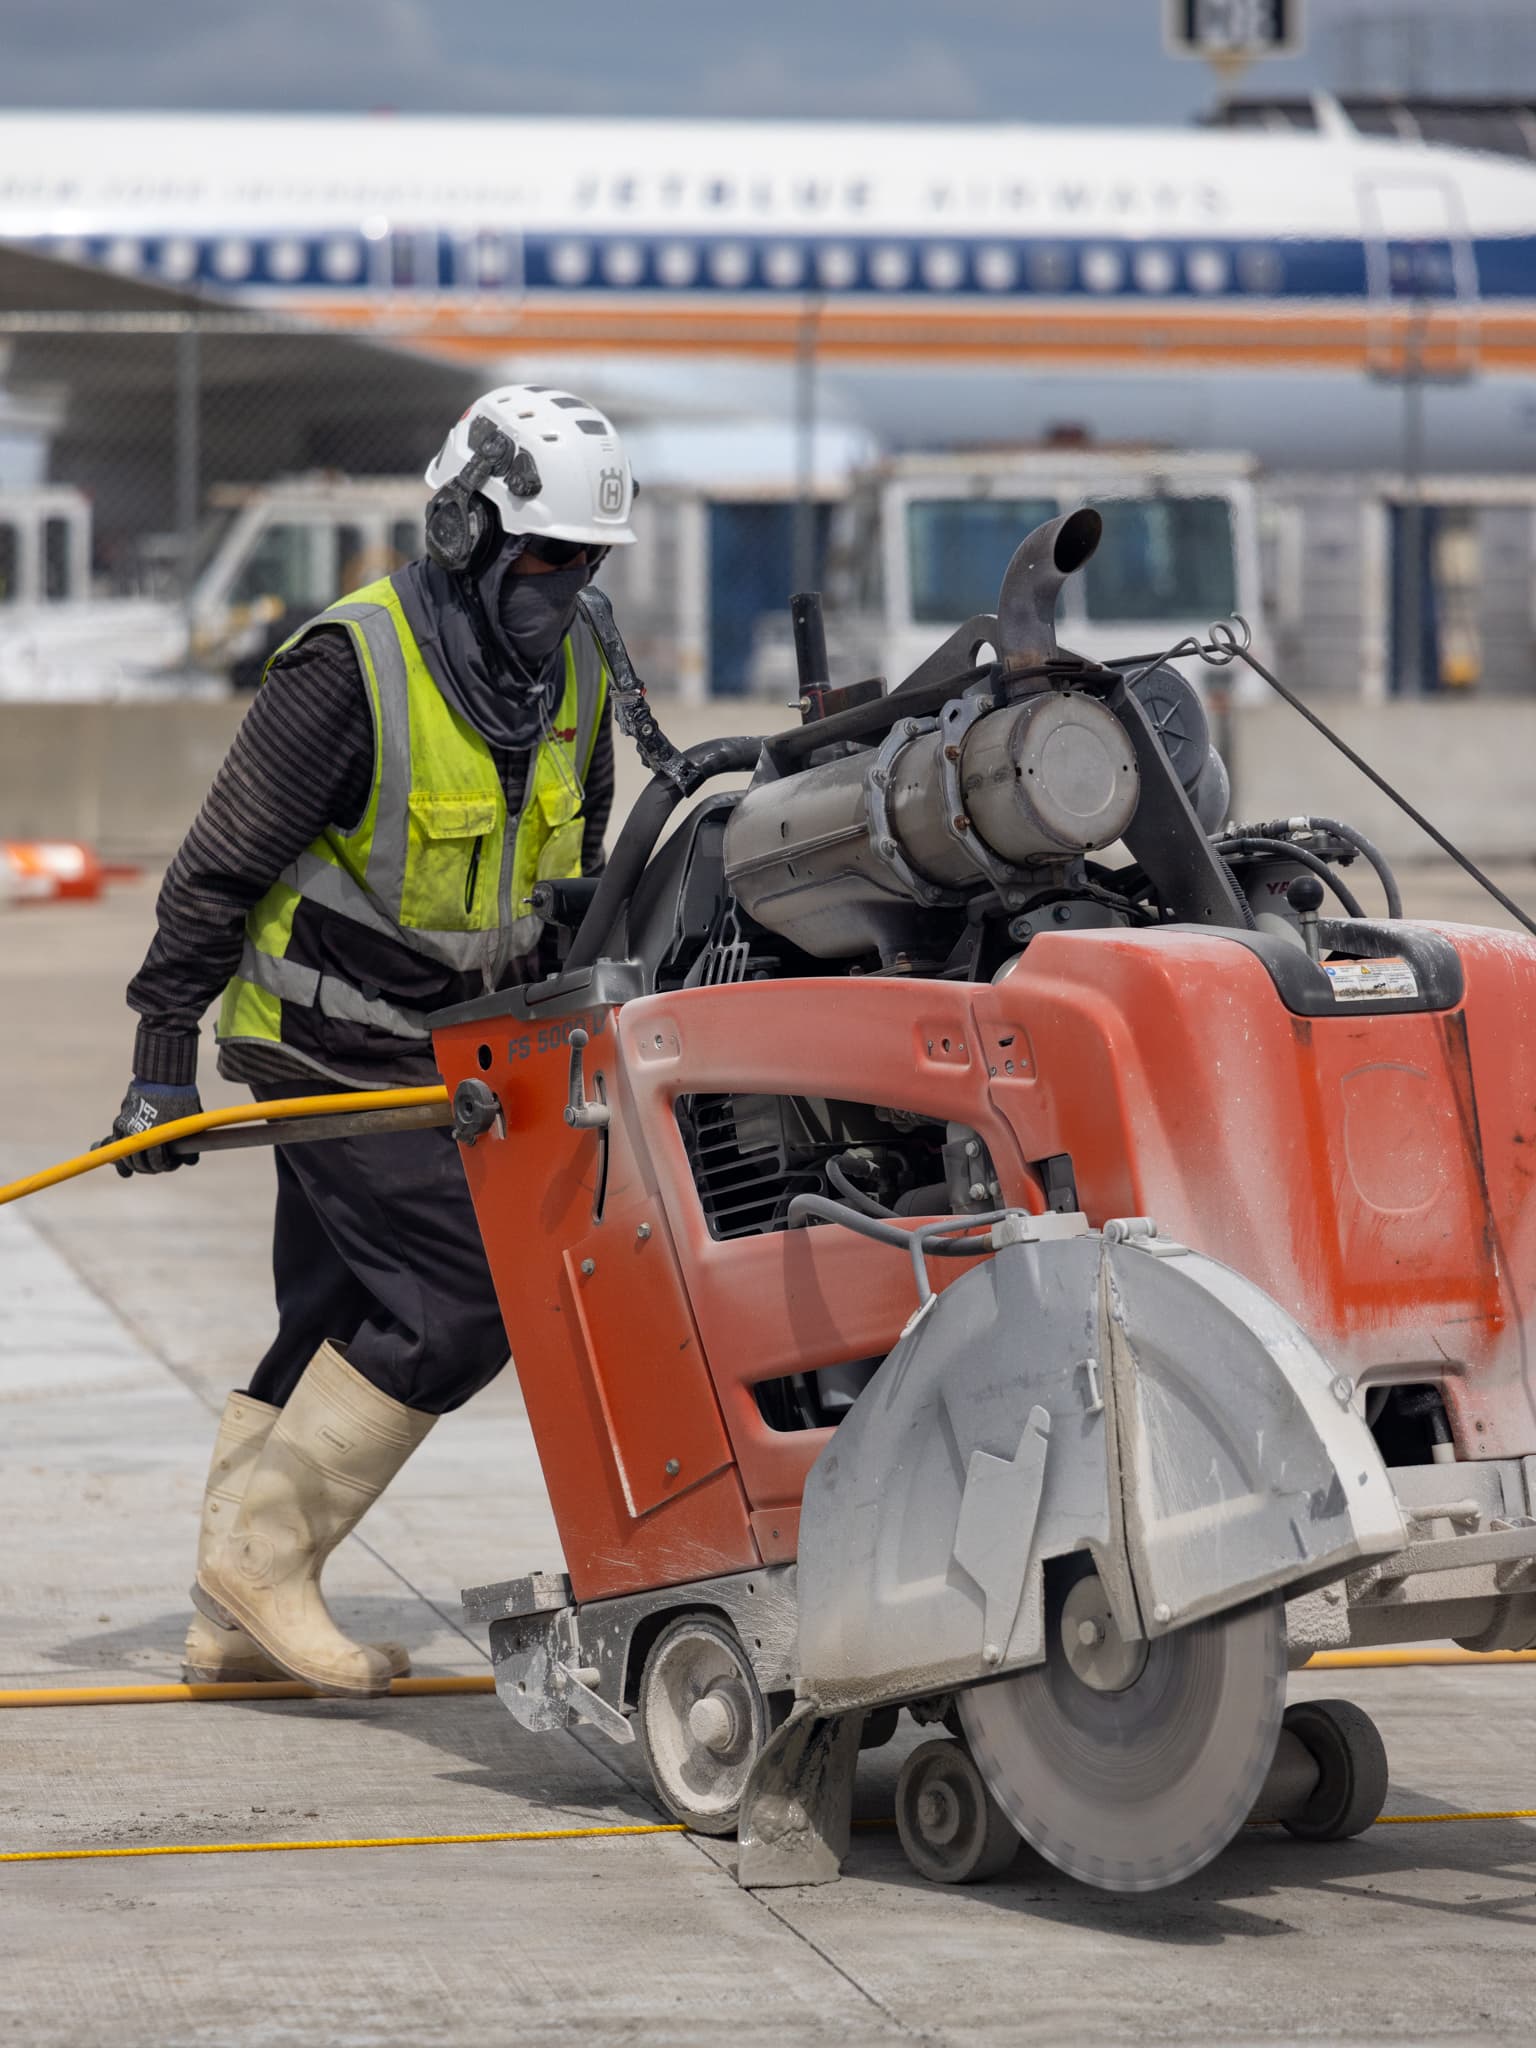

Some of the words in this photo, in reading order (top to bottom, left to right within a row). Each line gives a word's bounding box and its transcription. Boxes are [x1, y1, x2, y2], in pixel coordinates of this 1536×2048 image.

[574, 173, 872, 211] JETBLUE
[922, 177, 1224, 213] AIRWAYS
[508, 1035, 531, 1065] FS
